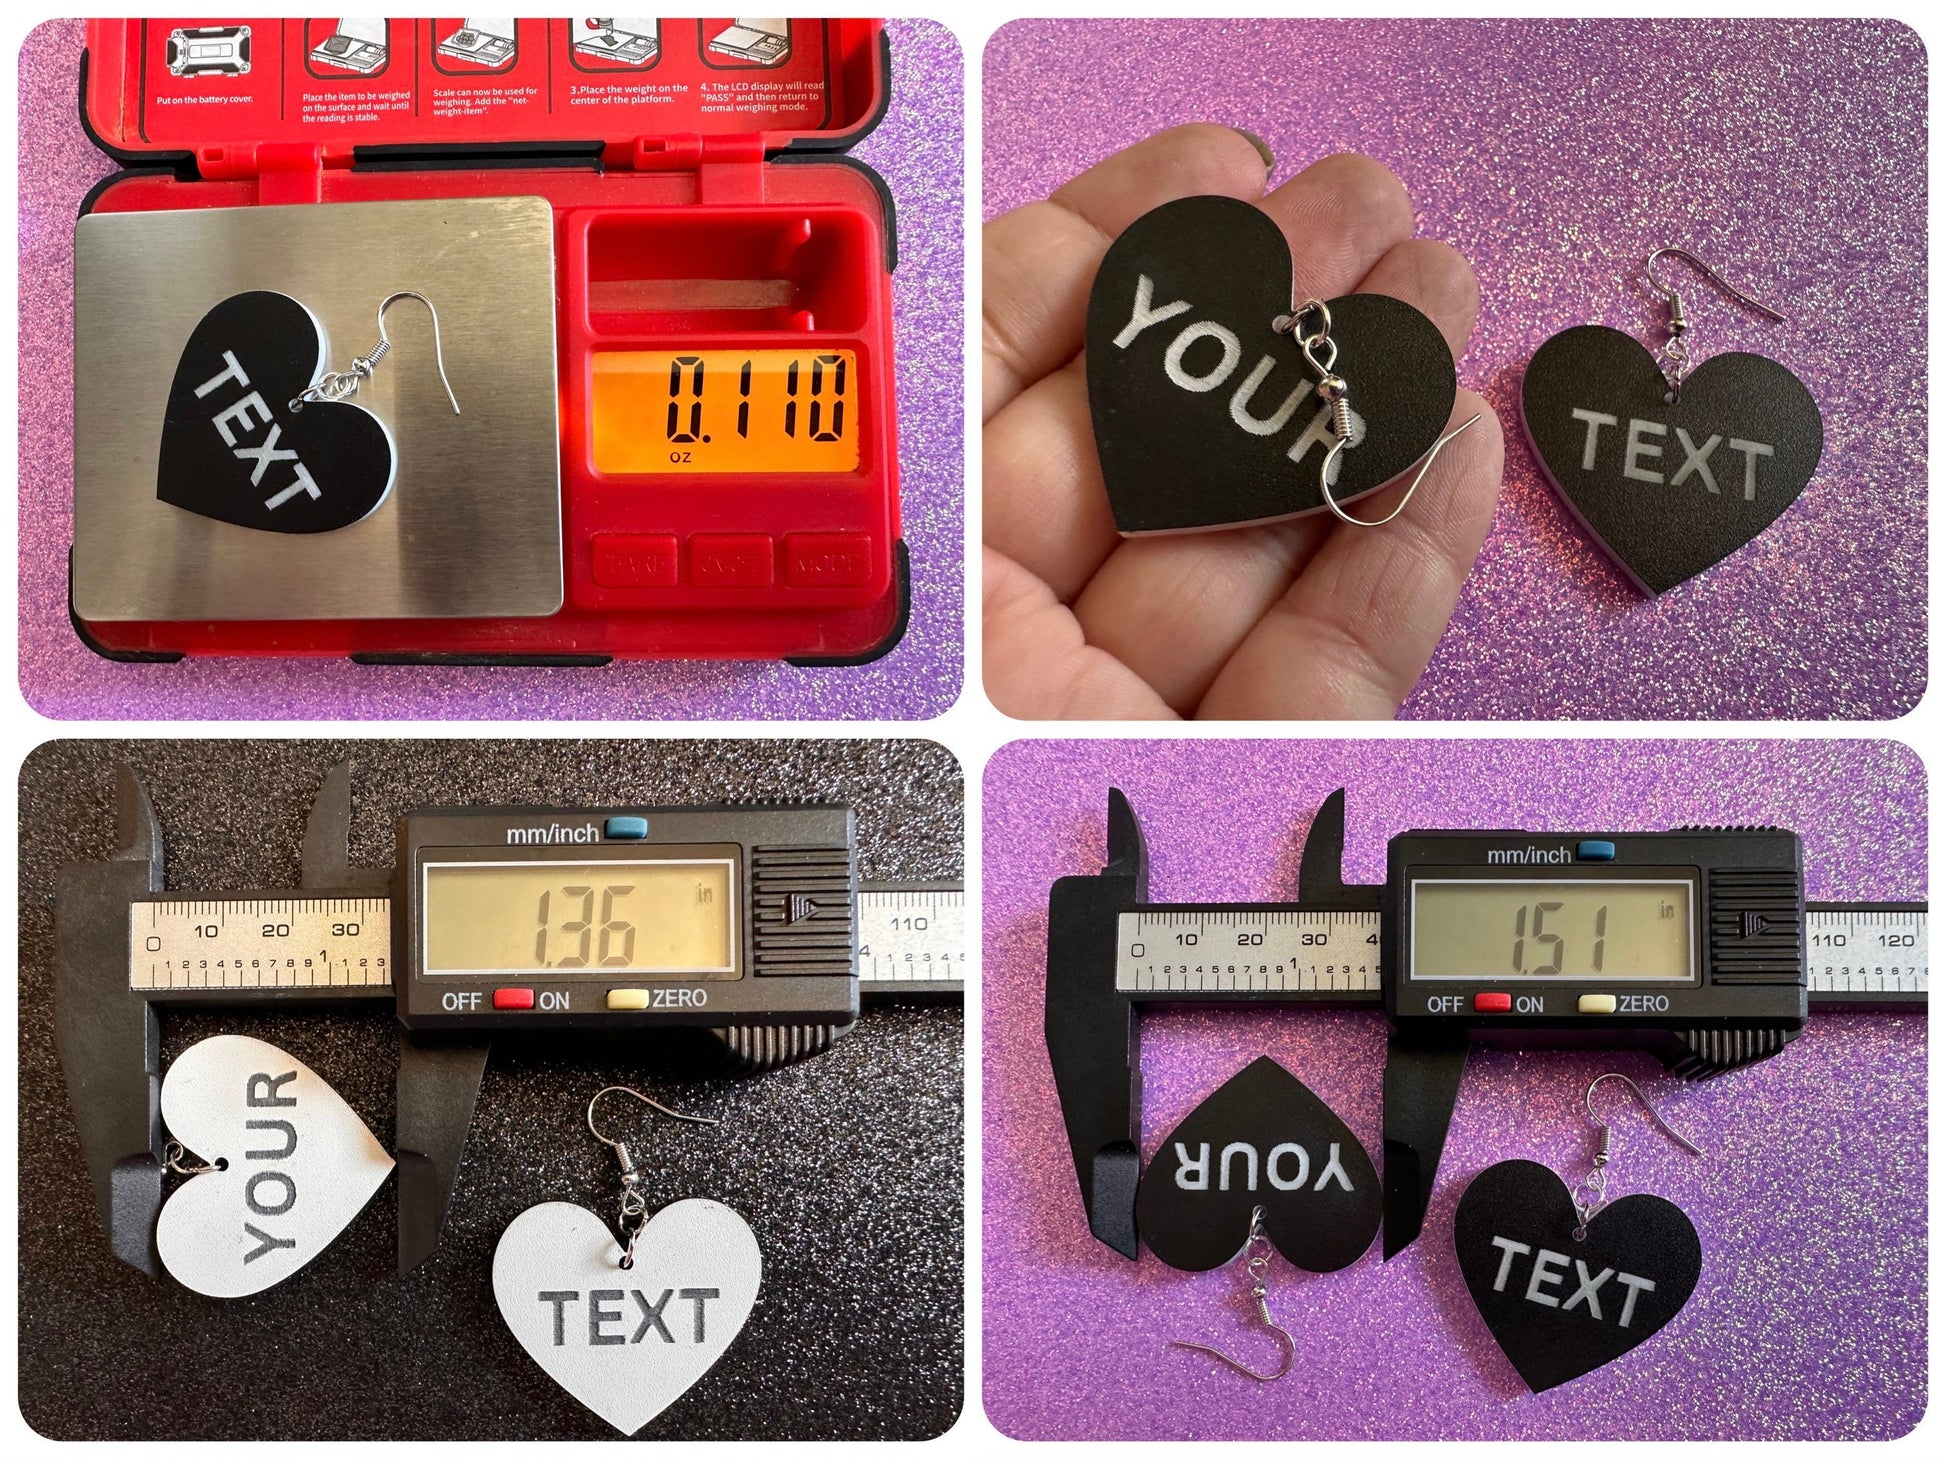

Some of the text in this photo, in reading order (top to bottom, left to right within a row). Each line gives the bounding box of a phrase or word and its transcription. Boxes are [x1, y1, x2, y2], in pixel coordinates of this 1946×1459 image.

[433, 89, 455, 97] Scale
[492, 87, 502, 95] be
[504, 87, 524, 95] used
[525, 87, 538, 95] for
[607, 84, 623, 94] the
[624, 84, 657, 95] weight
[658, 85, 670, 93] on
[672, 83, 689, 92] the
[700, 80, 825, 92] 4. The LCD display will read
[156, 96, 171, 105] Put
[184, 95, 198, 104] the
[199, 95, 228, 105] battery
[302, 90, 411, 102] Place the item to be weighed
[433, 96, 529, 108] weighing. Add the "net-
[570, 94, 675, 105] center of the platform.
[701, 92, 819, 102] "PASS" and then return to
[314, 103, 326, 111] the
[328, 102, 356, 111] surface
[357, 102, 372, 111] and
[373, 102, 390, 110] wait
[391, 101, 409, 110] until
[433, 106, 489, 117] weight-item".
[701, 101, 808, 114] normal weighing mode.
[302, 113, 380, 124] the reading is stable.
[1112, 273, 1367, 487] YOUR
[666, 354, 846, 443] 0.110
[193, 349, 322, 511] TEXT
[1570, 406, 1775, 501] TEXT
[507, 823, 599, 844] mm/inch
[1487, 845, 1572, 864] mm/inch
[194, 923, 360, 938] 10 20 30
[535, 885, 636, 968] 1.36
[891, 917, 928, 931] 110
[146, 936, 161, 952] 0
[1175, 933, 1198, 946] 10
[1237, 933, 1263, 946] 20
[1301, 933, 1327, 946] 30
[1512, 902, 1607, 975] 1.51
[1812, 934, 1915, 947] 110 120
[320, 949, 327, 963] 1
[859, 944, 871, 958] 4
[887, 953, 892, 962] 1
[904, 953, 913, 962] 2
[922, 953, 931, 962] 3
[941, 953, 949, 961] 4
[1131, 943, 1145, 958] 0
[165, 957, 385, 969] 1 2 3 4 5 6 7 8 9 1 2 3
[1148, 965, 1153, 973] 1
[1163, 965, 1171, 973] 2
[1179, 965, 1187, 973] 3
[1195, 965, 1203, 973] 4
[1211, 965, 1220, 973] 5
[1243, 965, 1251, 973] 7
[1259, 965, 1267, 973] 8
[1275, 965, 1283, 973] 9
[1310, 965, 1315, 973] 1
[1326, 965, 1334, 973] 2
[1342, 965, 1350, 973] 3
[1359, 965, 1366, 973] 4
[1290, 957, 1297, 970] 1
[1809, 966, 1814, 975] 1
[1825, 966, 1833, 975] 2
[1841, 966, 1850, 975] 3
[1858, 966, 1866, 975] 4
[1875, 966, 1883, 975] 5
[1908, 966, 1915, 975] 7
[442, 992, 483, 1011] OFF
[539, 991, 570, 1010] ON
[653, 989, 708, 1008] ZERO
[1427, 996, 1465, 1013] OFF
[1516, 996, 1544, 1013] ON
[1619, 995, 1669, 1012] ZERO
[244, 1069, 298, 1266] YOUR
[1174, 1141, 1355, 1192] YOUR
[1491, 1234, 1656, 1329] TEXT
[537, 1287, 720, 1347] TEXT
